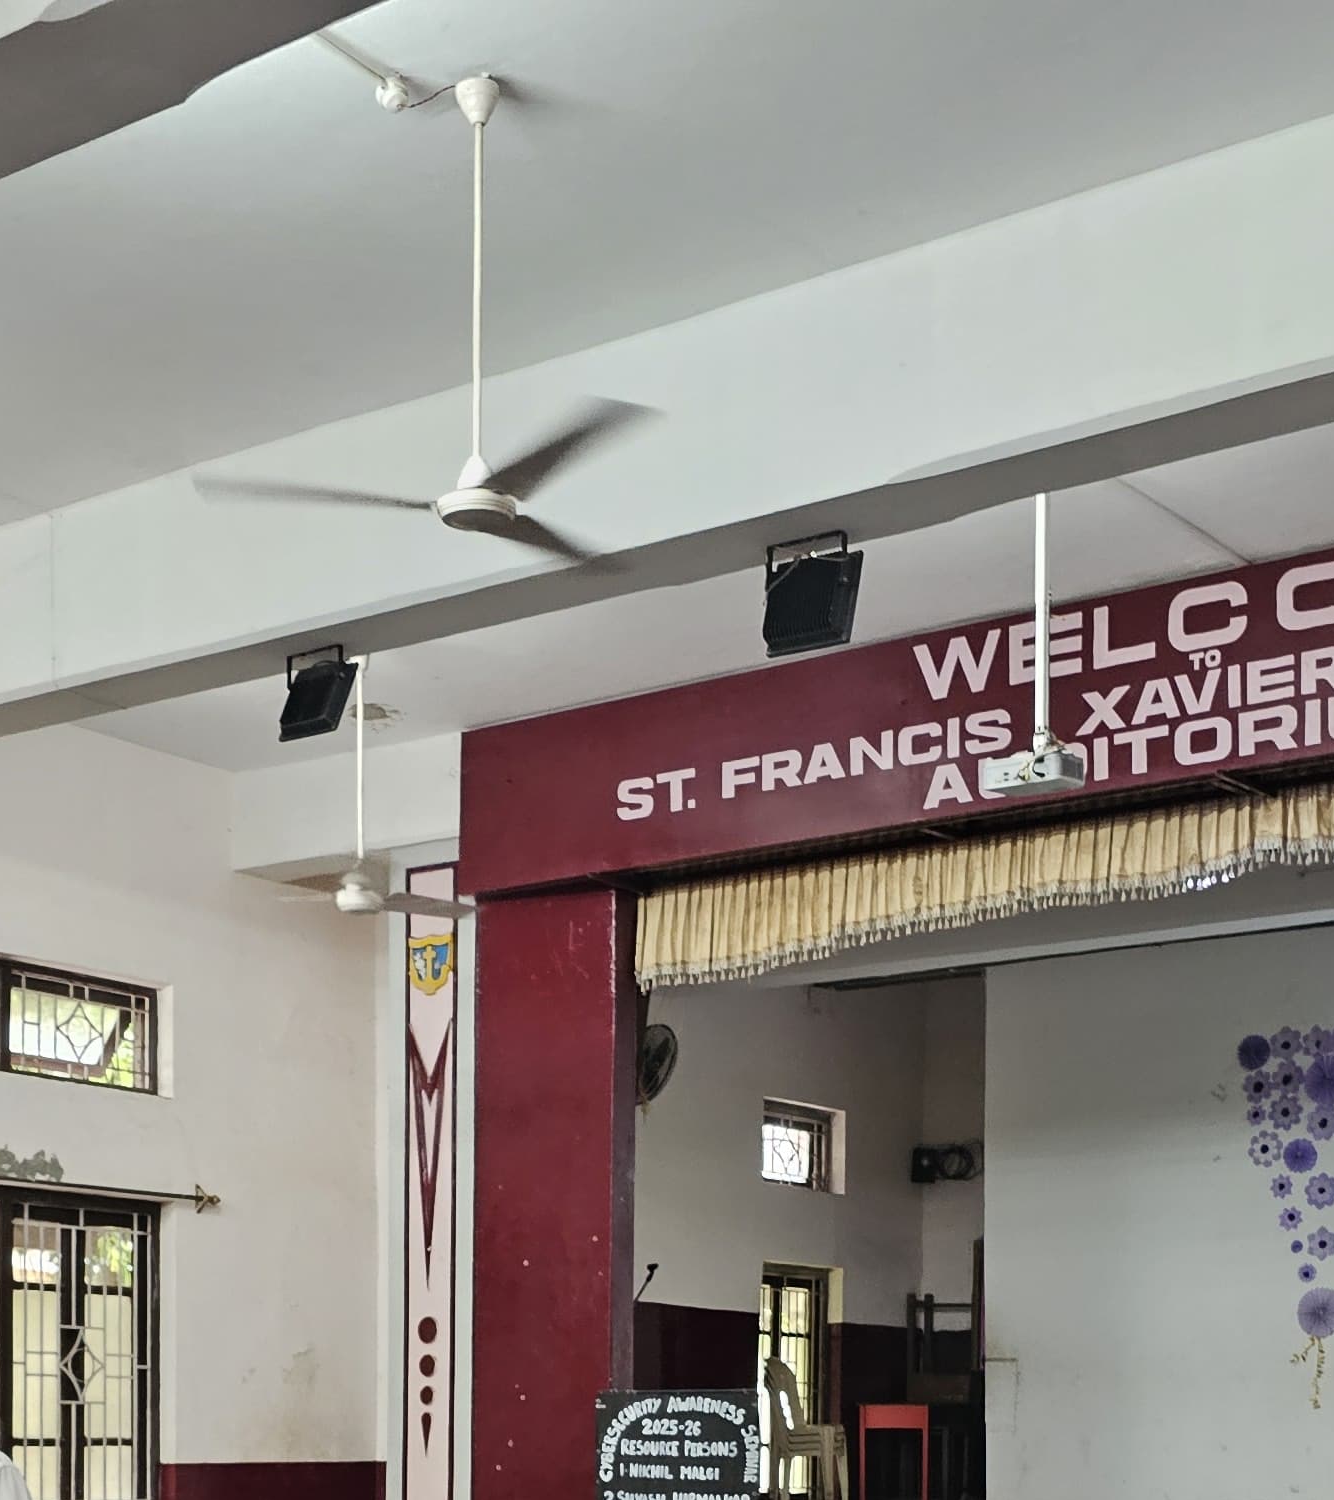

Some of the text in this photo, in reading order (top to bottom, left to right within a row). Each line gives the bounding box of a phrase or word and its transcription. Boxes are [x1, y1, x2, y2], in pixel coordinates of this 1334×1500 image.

[1189, 649, 1222, 671] TO
[616, 767, 697, 821] ST.
[721, 708, 1012, 799] FRANCIS
[666, 1395, 746, 1426] AWARENESS
[620, 1438, 738, 1459] RESOURCE PERSONS
[680, 1465, 720, 1481] MALGI
